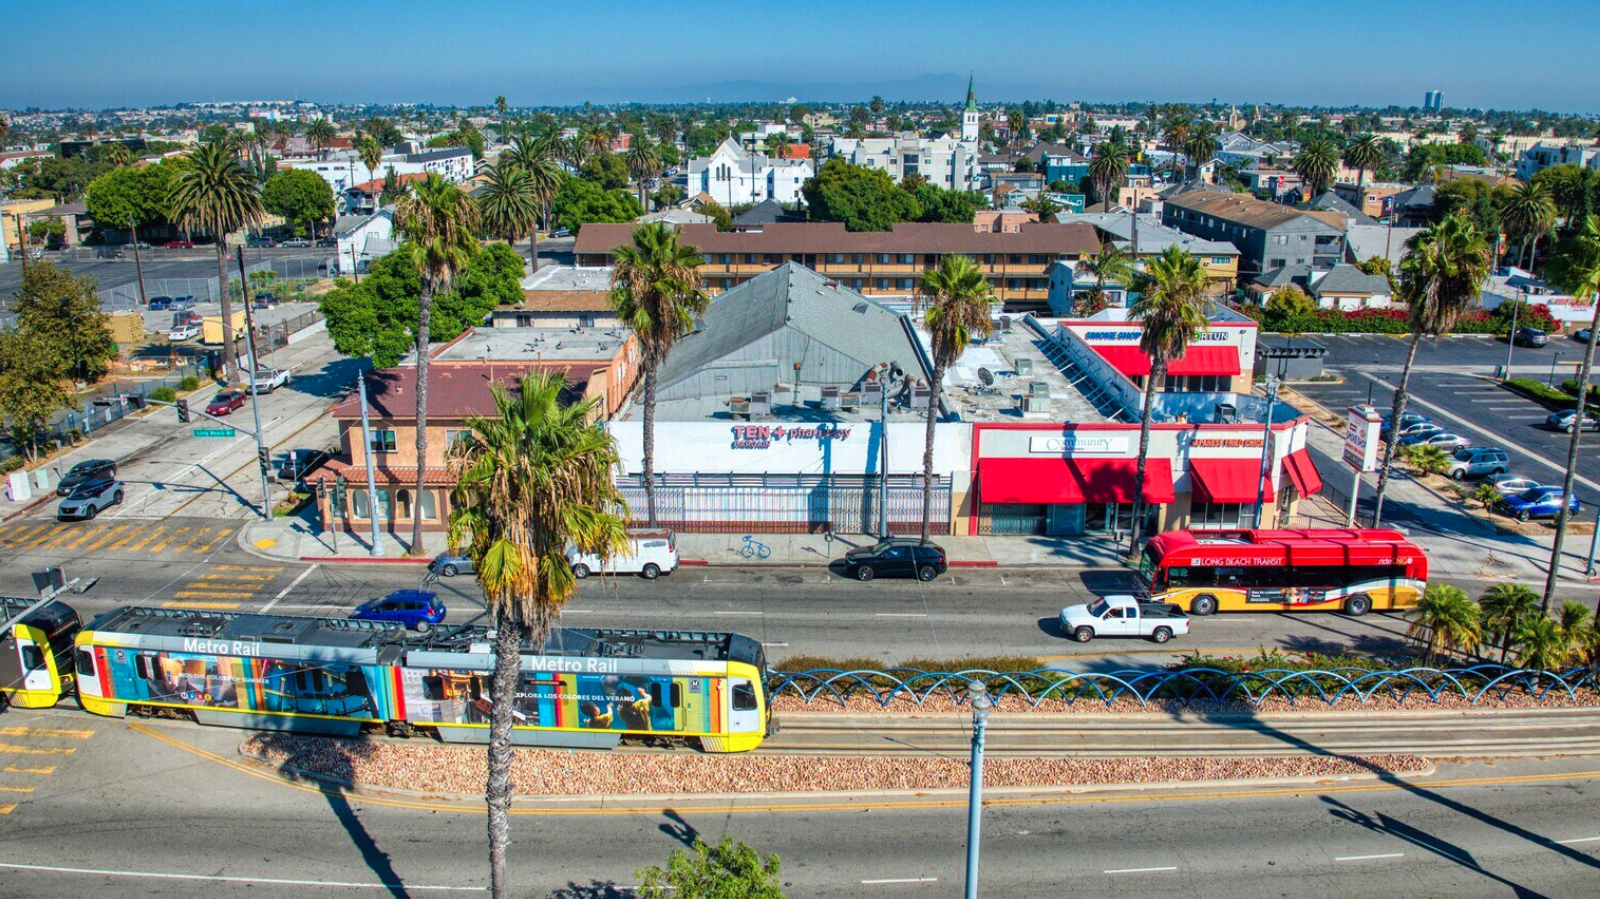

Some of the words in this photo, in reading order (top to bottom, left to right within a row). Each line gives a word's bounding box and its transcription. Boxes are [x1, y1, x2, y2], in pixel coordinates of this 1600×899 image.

[1085, 332, 1117, 340] SMOKE
[1117, 332, 1142, 340] SHOP
[1189, 330, 1229, 341] ORTUN
[734, 426, 770, 439] TEN
[184, 638, 228, 654] Metro
[233, 641, 260, 656] Rail
[531, 656, 582, 672] Metro
[587, 658, 617, 673] Rail
